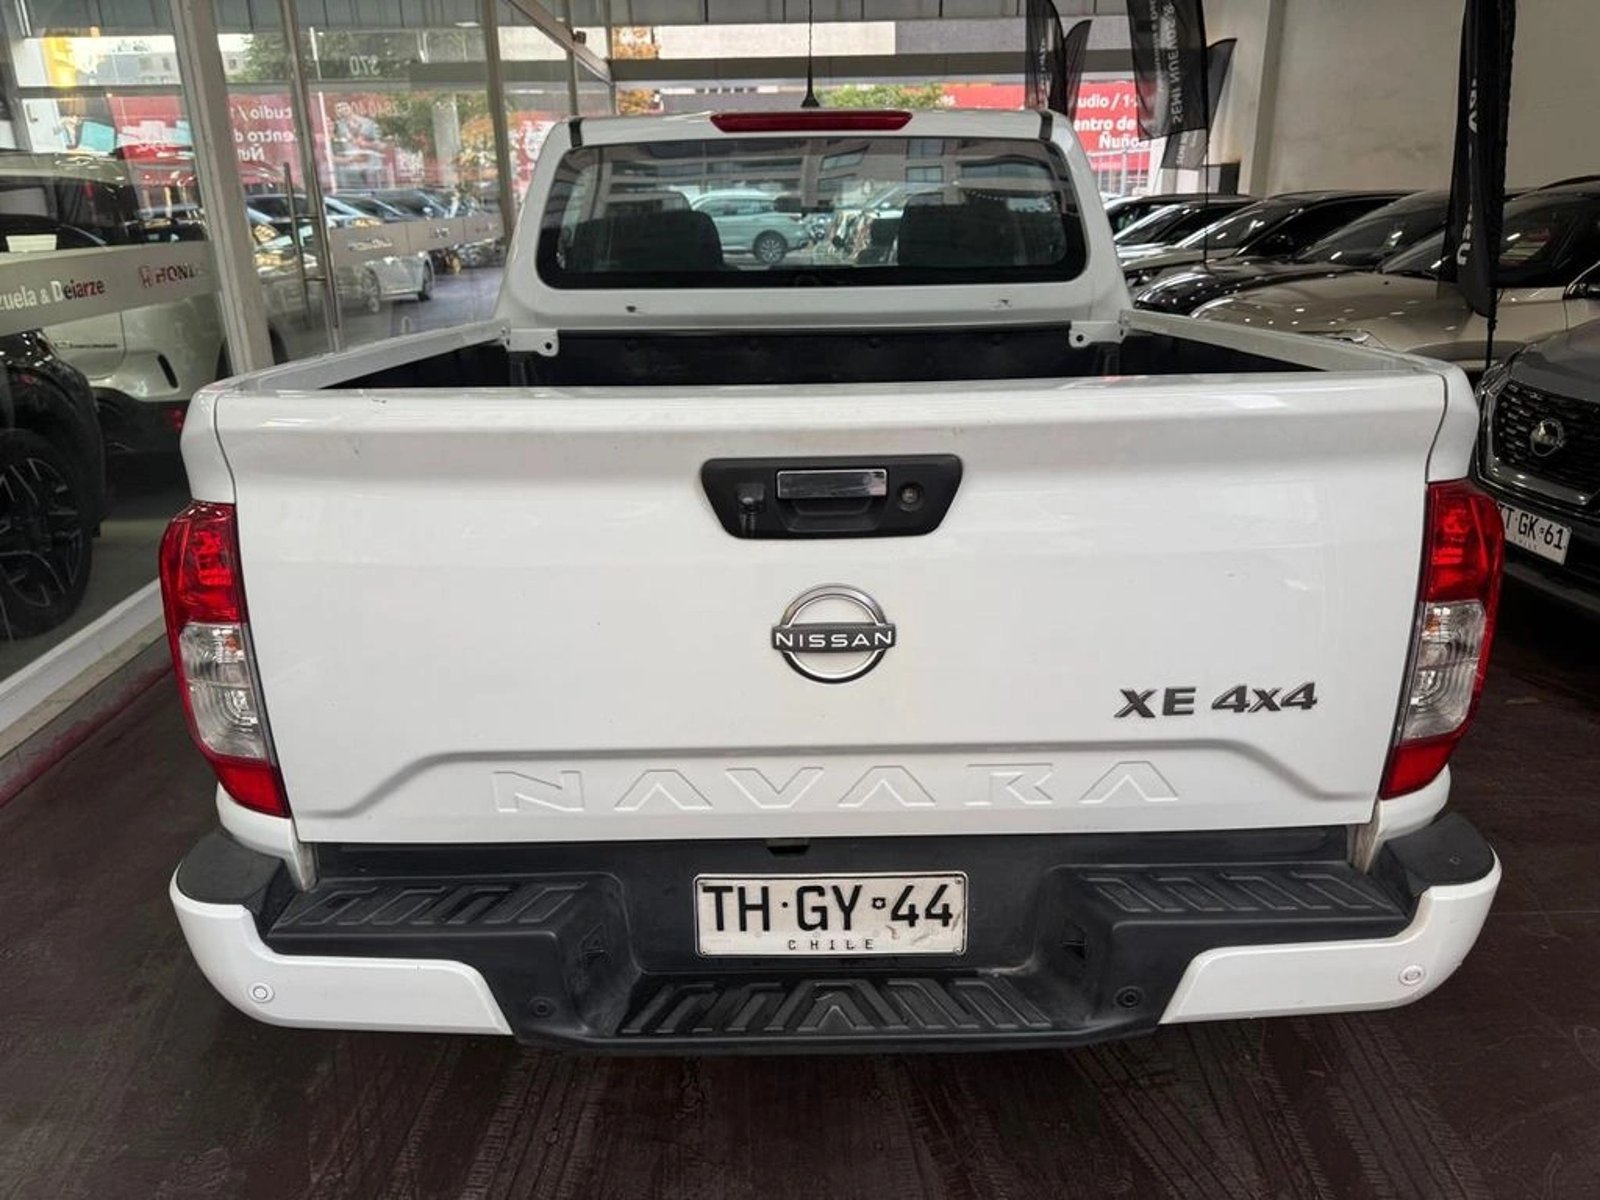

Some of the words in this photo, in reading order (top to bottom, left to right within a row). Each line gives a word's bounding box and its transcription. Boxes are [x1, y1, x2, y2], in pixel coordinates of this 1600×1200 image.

[1116, 115, 1137, 131] de
[40, 288, 50, 304] &
[775, 630, 892, 648] NISSAN
[1114, 686, 1196, 719] XE
[1212, 682, 1318, 714] 4x4
[492, 760, 1181, 813] NAVARA
[788, 938, 875, 951] CHILE
